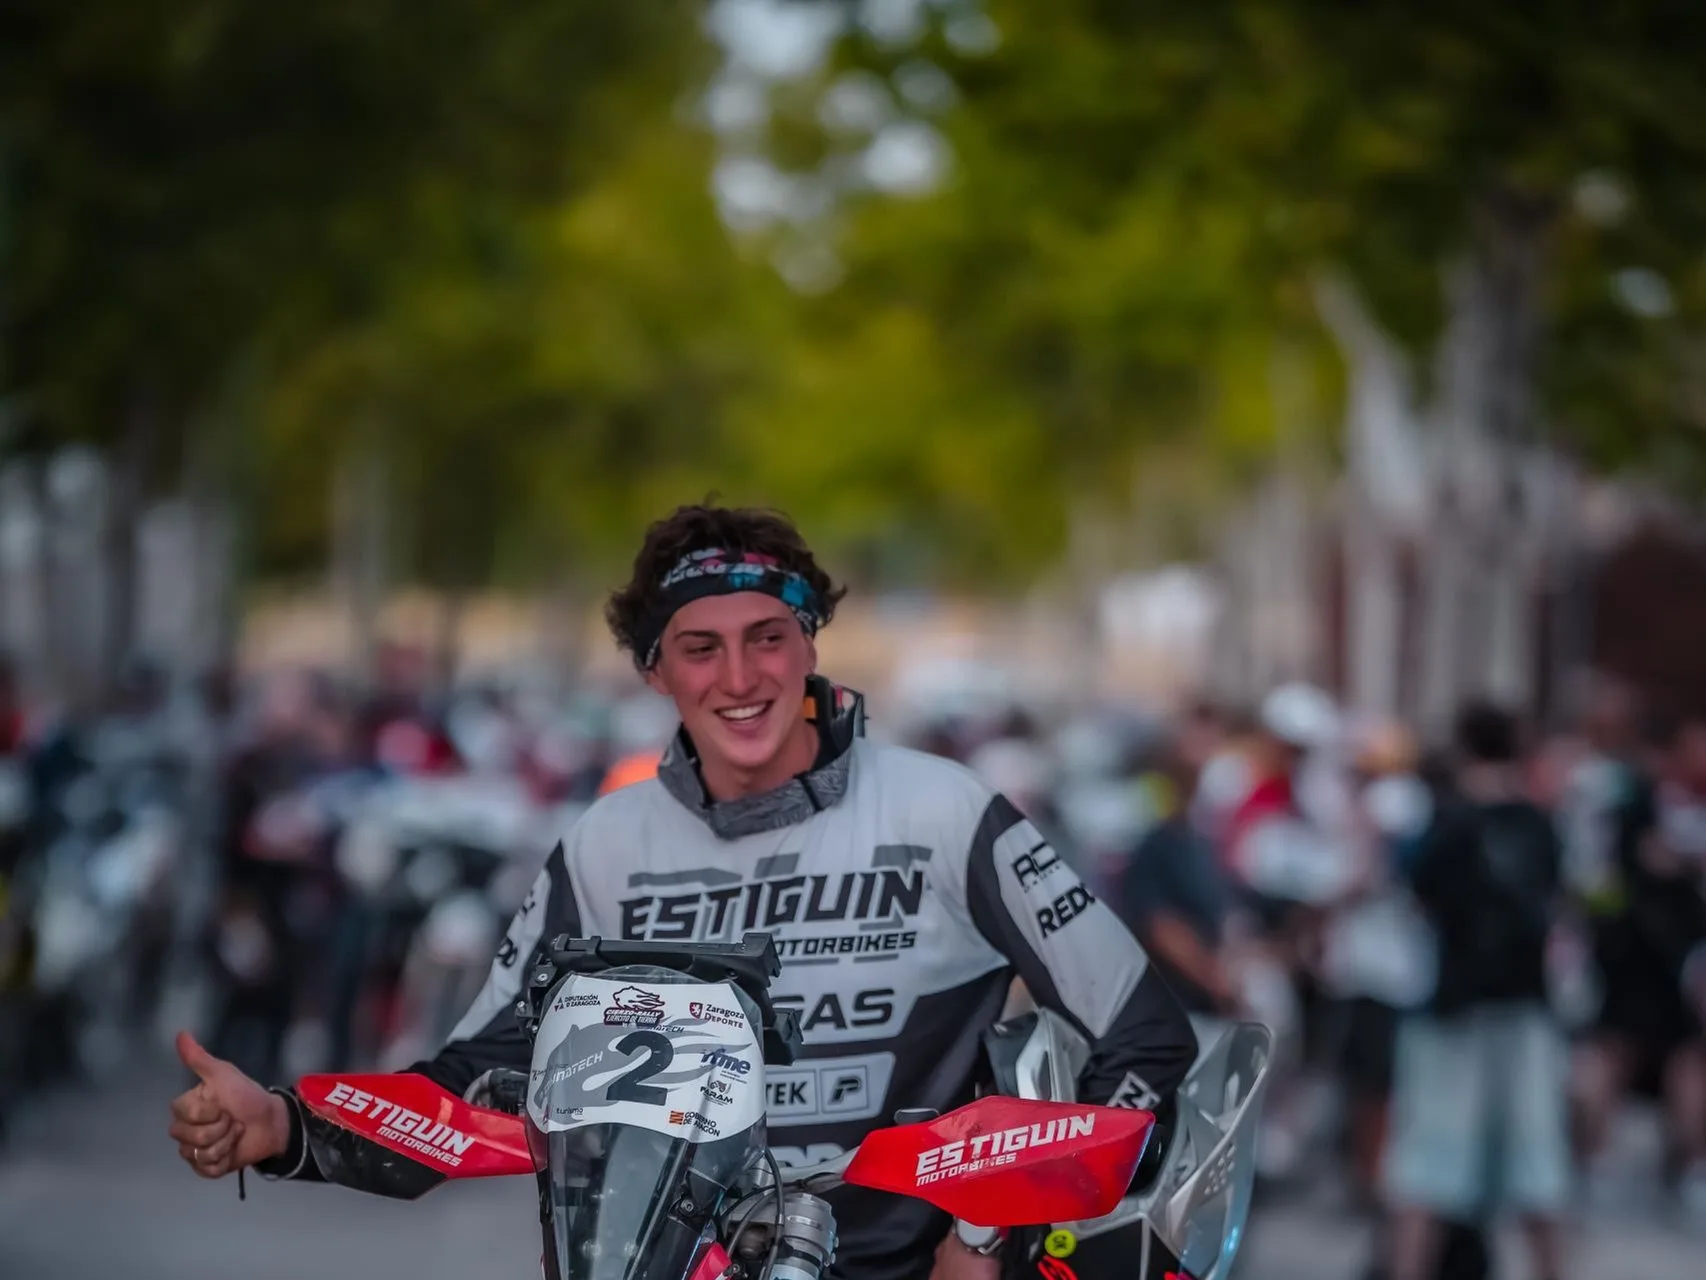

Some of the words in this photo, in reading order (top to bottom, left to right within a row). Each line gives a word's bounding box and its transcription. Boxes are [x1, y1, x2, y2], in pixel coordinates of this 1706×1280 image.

[617, 870, 924, 940] ESTIGUIN
[776, 930, 918, 956] OTORBIKES
[704, 1013, 743, 1028] DEPORTE
[706, 1004, 744, 1019] Zaragoza
[606, 1031, 674, 1106] 2
[324, 1082, 476, 1156] ESTIGUIN
[915, 1112, 1096, 1176] ESTIGUIN
[376, 1126, 463, 1167] MOTORBIKES
